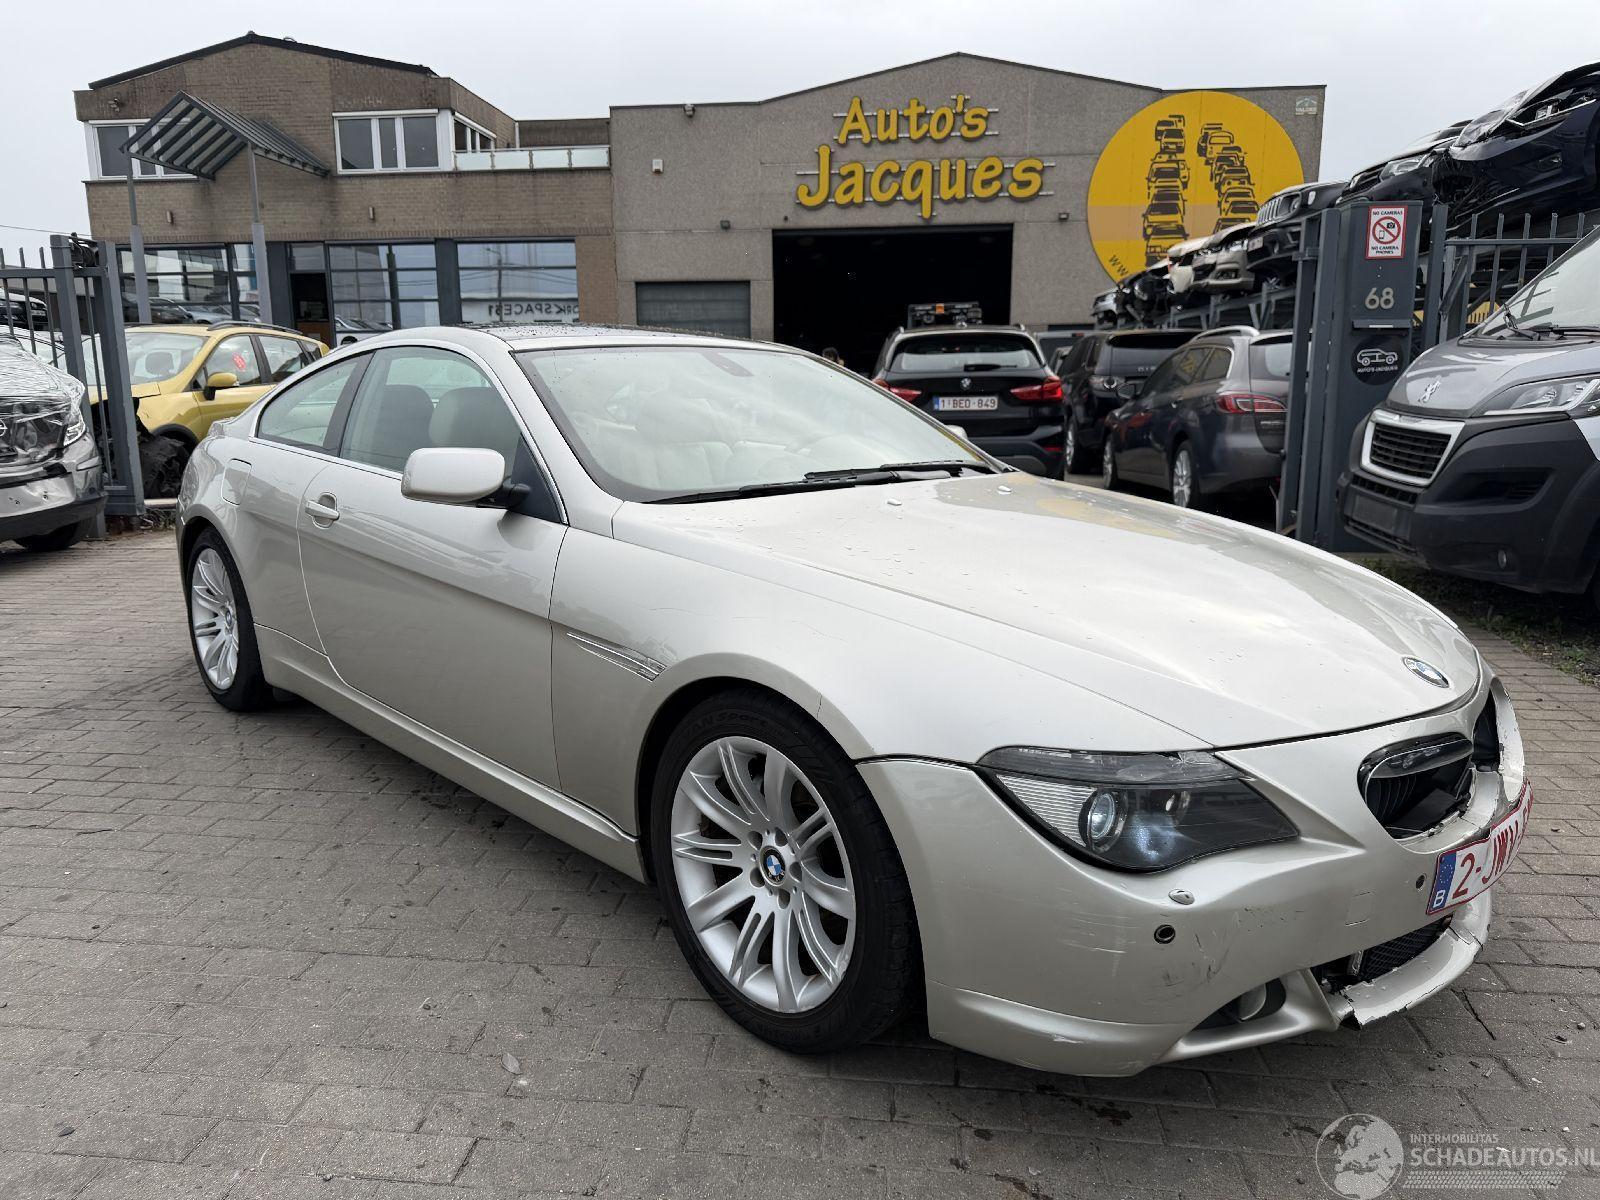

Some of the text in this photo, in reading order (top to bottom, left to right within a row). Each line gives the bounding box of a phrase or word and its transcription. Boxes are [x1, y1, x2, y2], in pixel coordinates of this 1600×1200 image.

[837, 94, 989, 145] Auto's
[796, 144, 1044, 220] Jacques
[1364, 287, 1395, 310] 68
[1432, 889, 1446, 909] B
